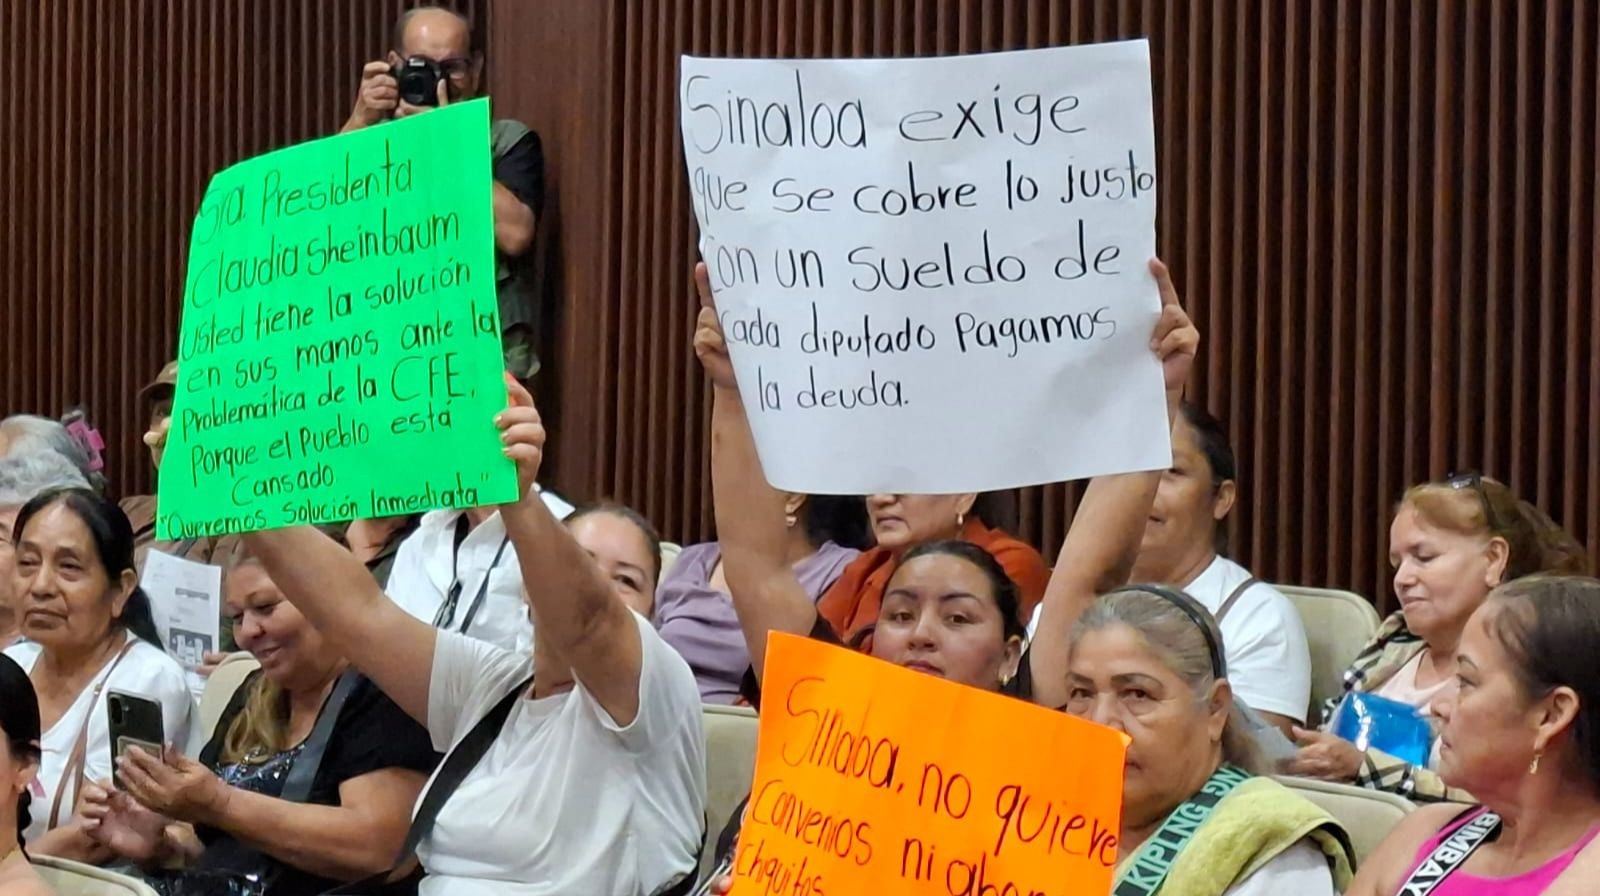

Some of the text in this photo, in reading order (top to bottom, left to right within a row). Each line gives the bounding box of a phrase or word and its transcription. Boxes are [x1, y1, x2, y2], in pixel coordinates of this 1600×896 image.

[686, 69, 1087, 154] Sinaloa exige
[261, 138, 412, 226] Presidenta
[694, 166, 747, 227] que
[853, 161, 977, 216] cobre
[1006, 160, 1038, 210] lo
[1060, 150, 1154, 204] justo
[191, 207, 458, 308] Claudia Sheinbaum
[775, 249, 823, 288] un
[1054, 219, 1121, 280] de
[182, 258, 470, 362] Usted tiene la solución
[187, 365, 221, 393] en
[296, 330, 379, 371] manos
[401, 309, 453, 350] ante
[471, 300, 498, 338] la
[800, 302, 936, 357] diputado
[318, 370, 345, 406] de
[356, 365, 377, 404] la
[758, 365, 909, 412] la deuda.
[269, 431, 292, 459] el
[391, 399, 452, 434] está
[231, 463, 334, 506] Cansado
[919, 763, 971, 819] no
[995, 784, 1118, 867] quiere
[901, 838, 936, 881] ni
